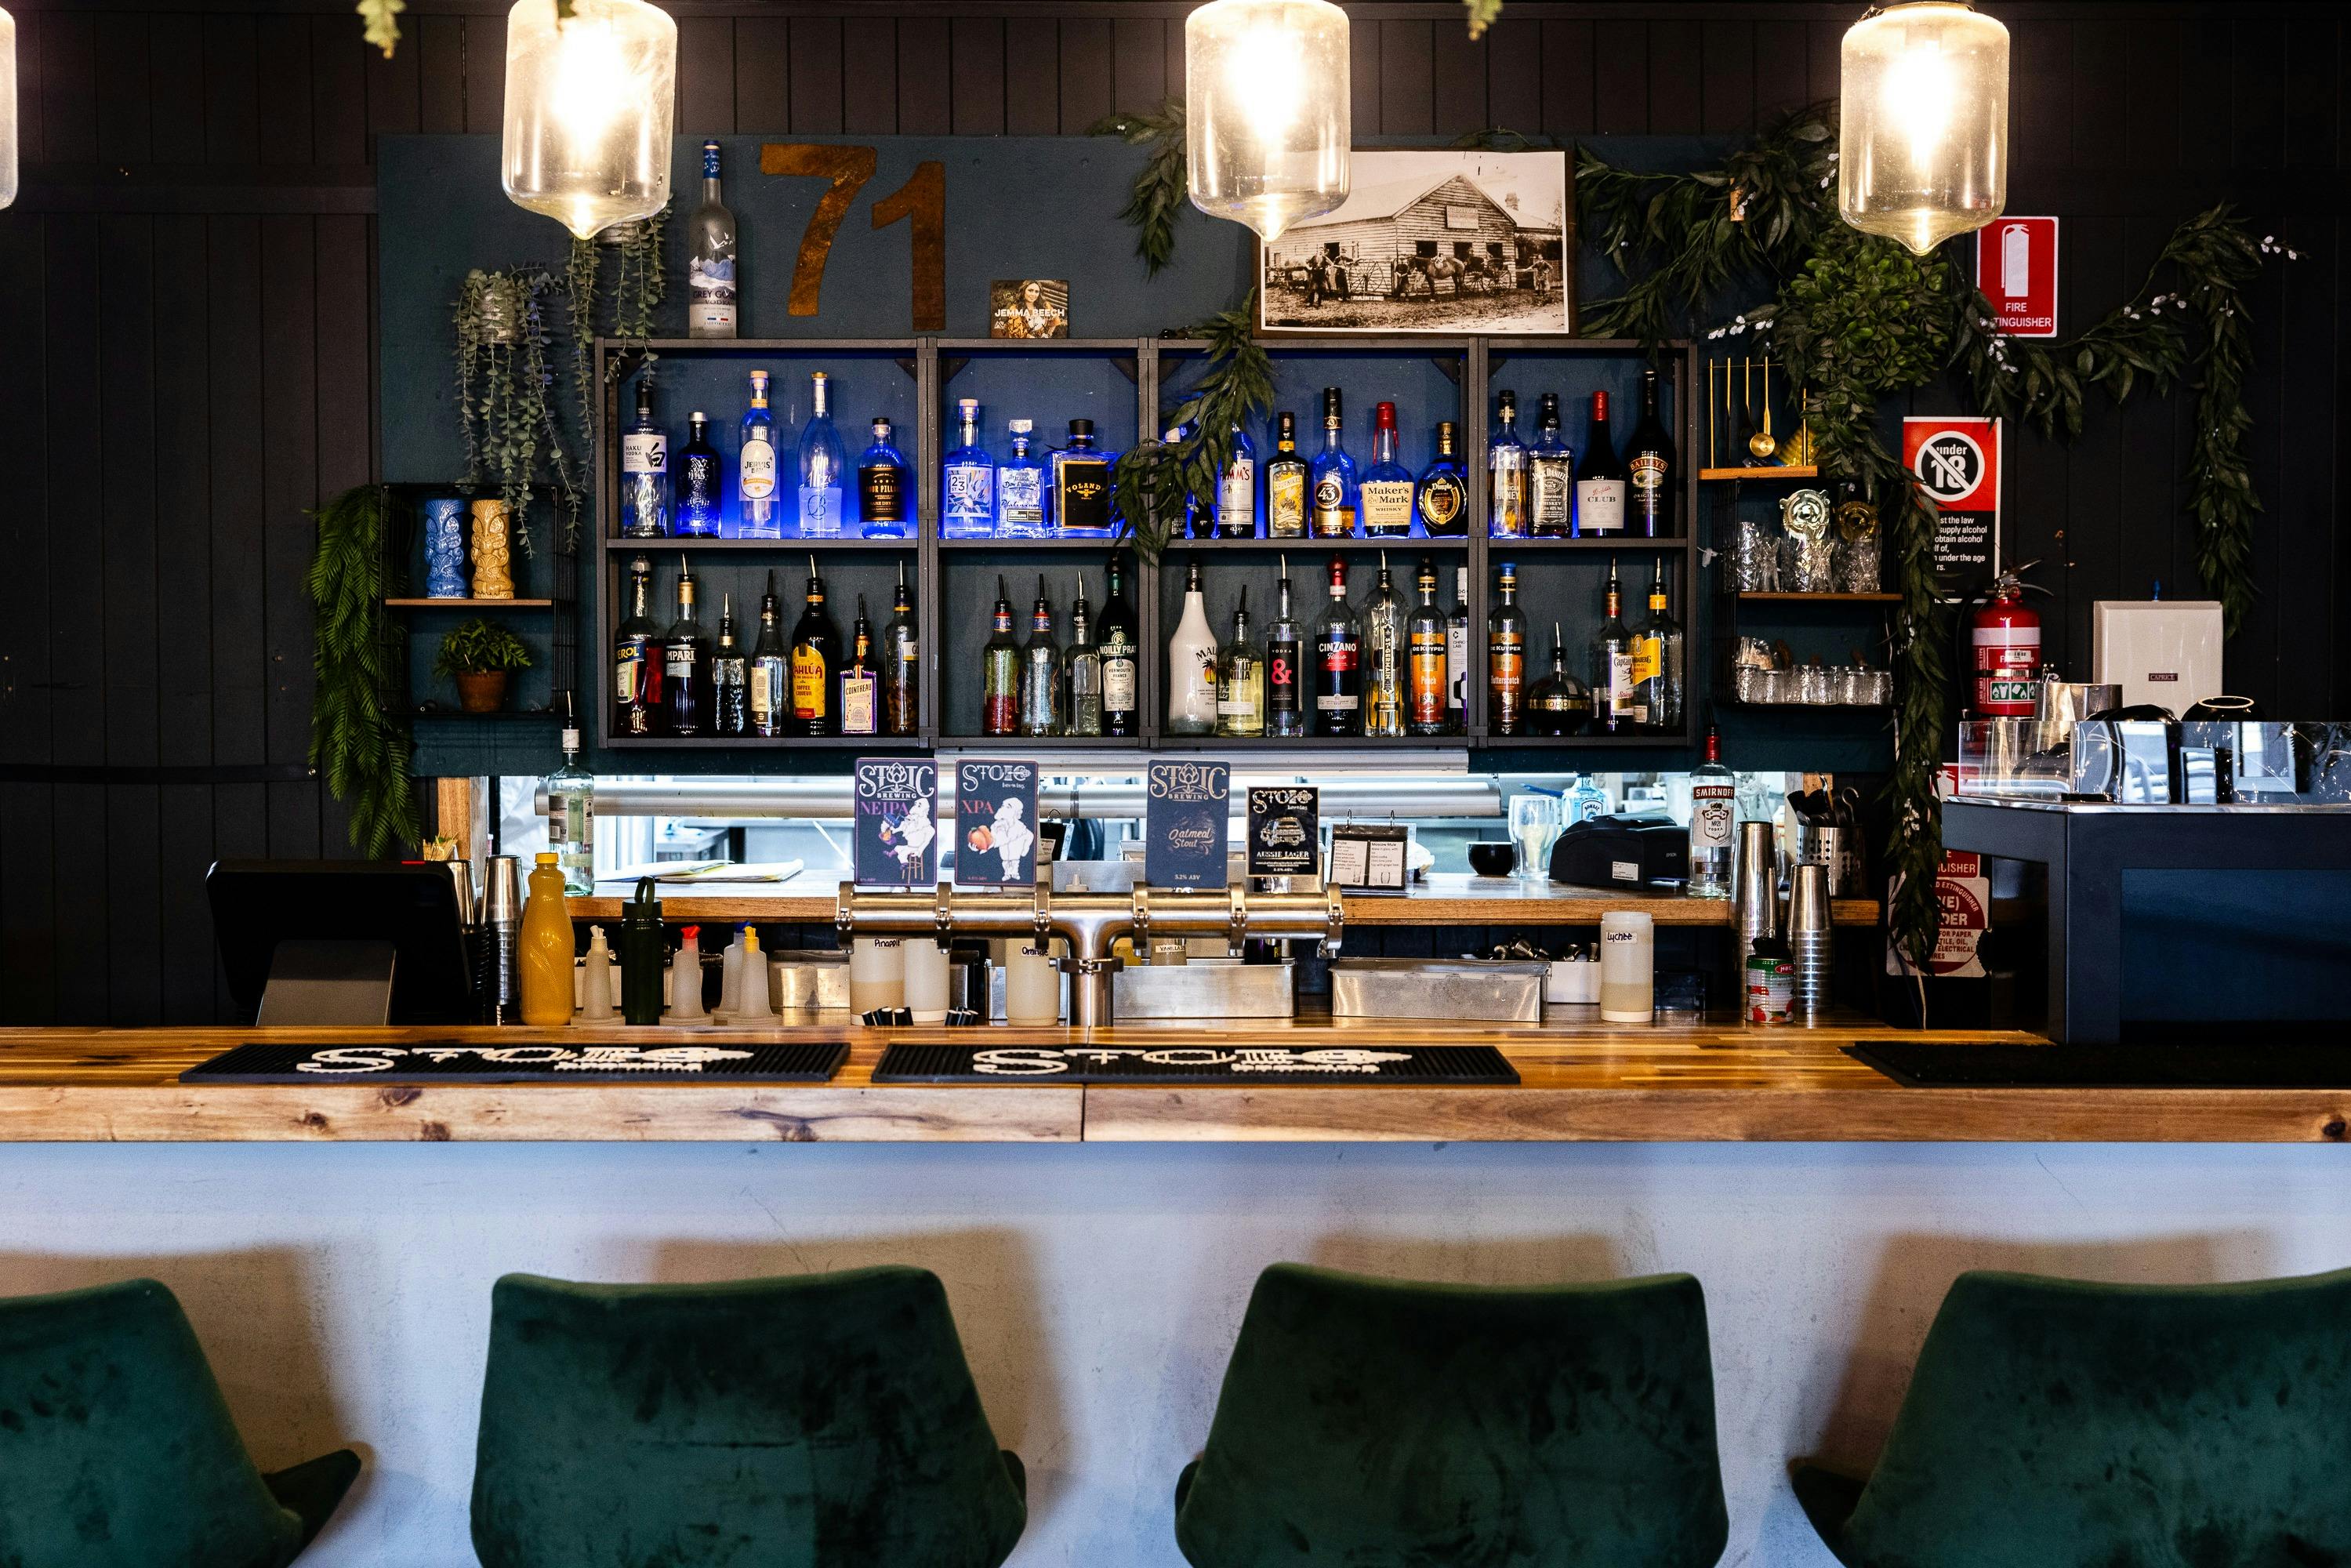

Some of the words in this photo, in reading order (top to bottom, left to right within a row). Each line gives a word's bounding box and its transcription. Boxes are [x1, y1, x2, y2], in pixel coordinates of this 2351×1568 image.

[760, 143, 946, 332] 71
[693, 290, 713, 299] GREY
[715, 290, 734, 299] GOO
[994, 308, 1030, 318] JEMMA
[1032, 308, 1065, 318] BEECH
[2005, 302, 2027, 313] FIRE
[1993, 317, 2052, 328] TINGUISHER
[1936, 444, 1968, 456] under
[1630, 458, 1666, 470] BAILEYS
[1931, 455, 1967, 489] 18
[1318, 487, 1336, 501] 43
[1496, 491, 1519, 499] HONEY
[1948, 516, 1960, 524] the
[1939, 526, 1961, 535] supply
[1940, 544, 1950, 553] of,
[1972, 555, 1986, 564] age
[617, 646, 640, 659] EROL
[1099, 644, 1121, 655] NOILLY
[1123, 644, 1137, 655] PRAT
[1319, 641, 1357, 652] CINZANO
[667, 650, 696, 662] MPARI.
[1195, 646, 1217, 661] MAL
[1490, 675, 1520, 684] Butterscotch
[845, 683, 872, 695] COINTREAU
[859, 762, 935, 797] STOIC
[963, 764, 1032, 792] STOIC
[1149, 762, 1227, 800] STOIC
[1696, 788, 1734, 797] SMIRNOFF
[961, 800, 995, 815] XPA
[1252, 789, 1314, 814] STOIC
[860, 800, 909, 816] NEIPA
[1168, 827, 1212, 840] Oatmeal
[1173, 838, 1198, 848] Stout
[1942, 881, 1979, 913] EXTINGUISHER
[1942, 913, 1968, 926] DER
[1607, 932, 1633, 943] Lychee
